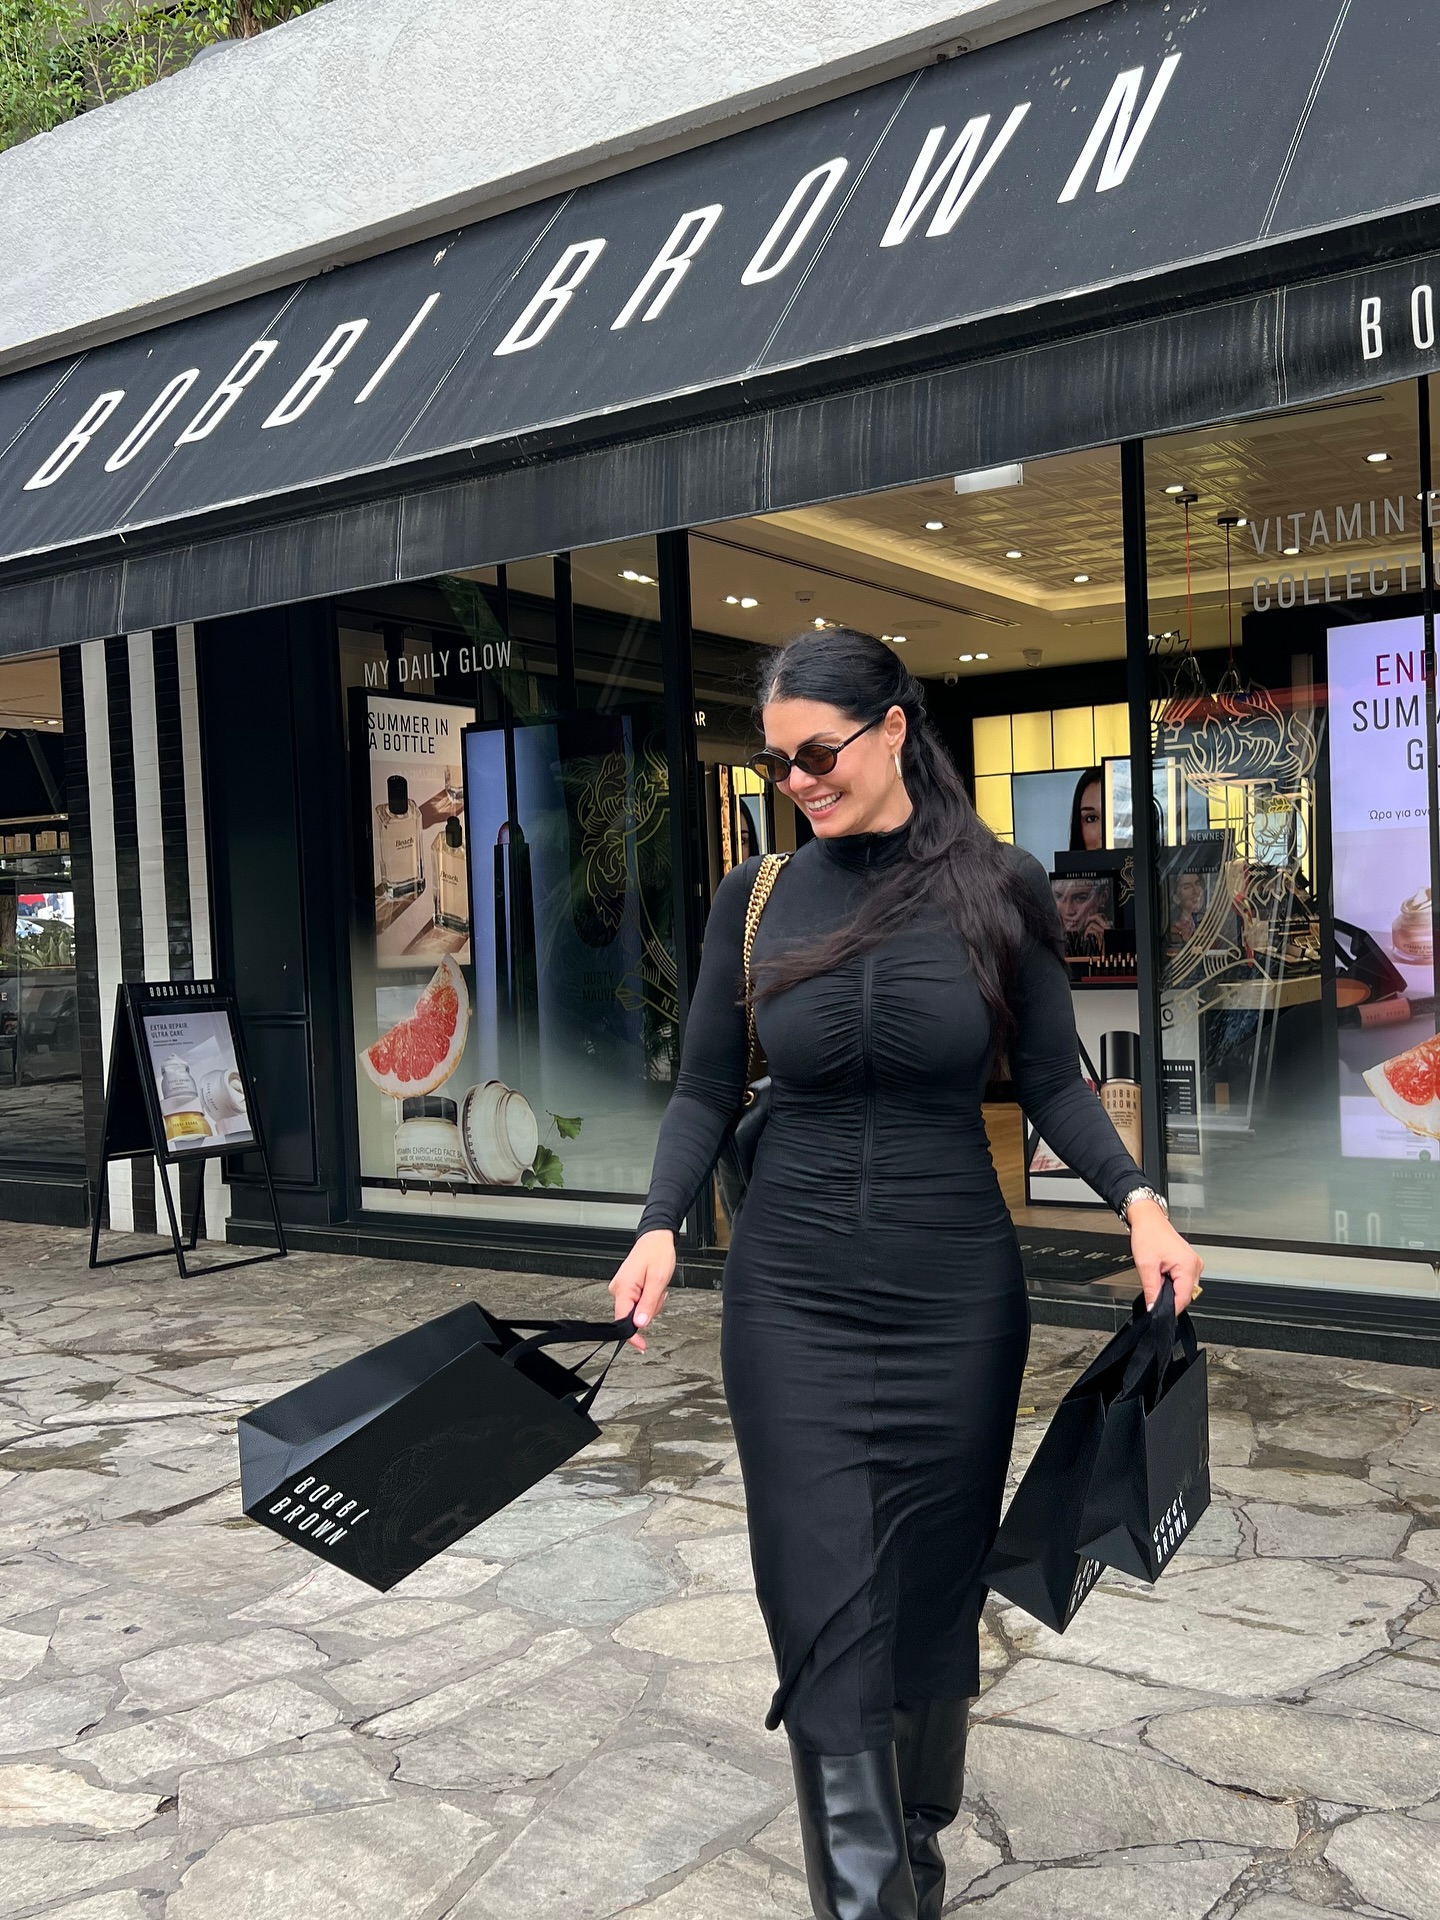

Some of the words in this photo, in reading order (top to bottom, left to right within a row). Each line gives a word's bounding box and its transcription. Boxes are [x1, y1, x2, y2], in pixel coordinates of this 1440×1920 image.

[23, 293, 440, 490] BOBBI
[493, 51, 1182, 357] BROWN
[1360, 284, 1435, 361] BO
[1250, 496, 1405, 555] VITAMIN
[364, 659, 390, 688] MY
[398, 650, 450, 683] DAILY
[459, 641, 512, 673] GLOW
[367, 711, 430, 733] SUMMER
[434, 717, 449, 736] IN
[1352, 694, 1440, 733] SUM
[368, 735, 378, 750] A
[383, 736, 436, 754] BOTTLE
[1406, 738, 1440, 771] G
[1368, 809, 1392, 821] Ώρα
[1395, 810, 1411, 820] για
[149, 985, 179, 997] BOBBI
[184, 983, 216, 996] BROWN
[583, 971, 614, 985] DUSTY
[150, 1023, 168, 1032] EXTRA
[1106, 1088, 1136, 1099] BOBBI
[1106, 1099, 1137, 1109] BROWN
[412, 1146, 442, 1156] ENRICHED
[443, 1148, 457, 1158] FACE
[293, 1475, 370, 1526] BOBBI
[268, 1496, 348, 1547] BROWN
[1156, 1509, 1188, 1564] BROWN
